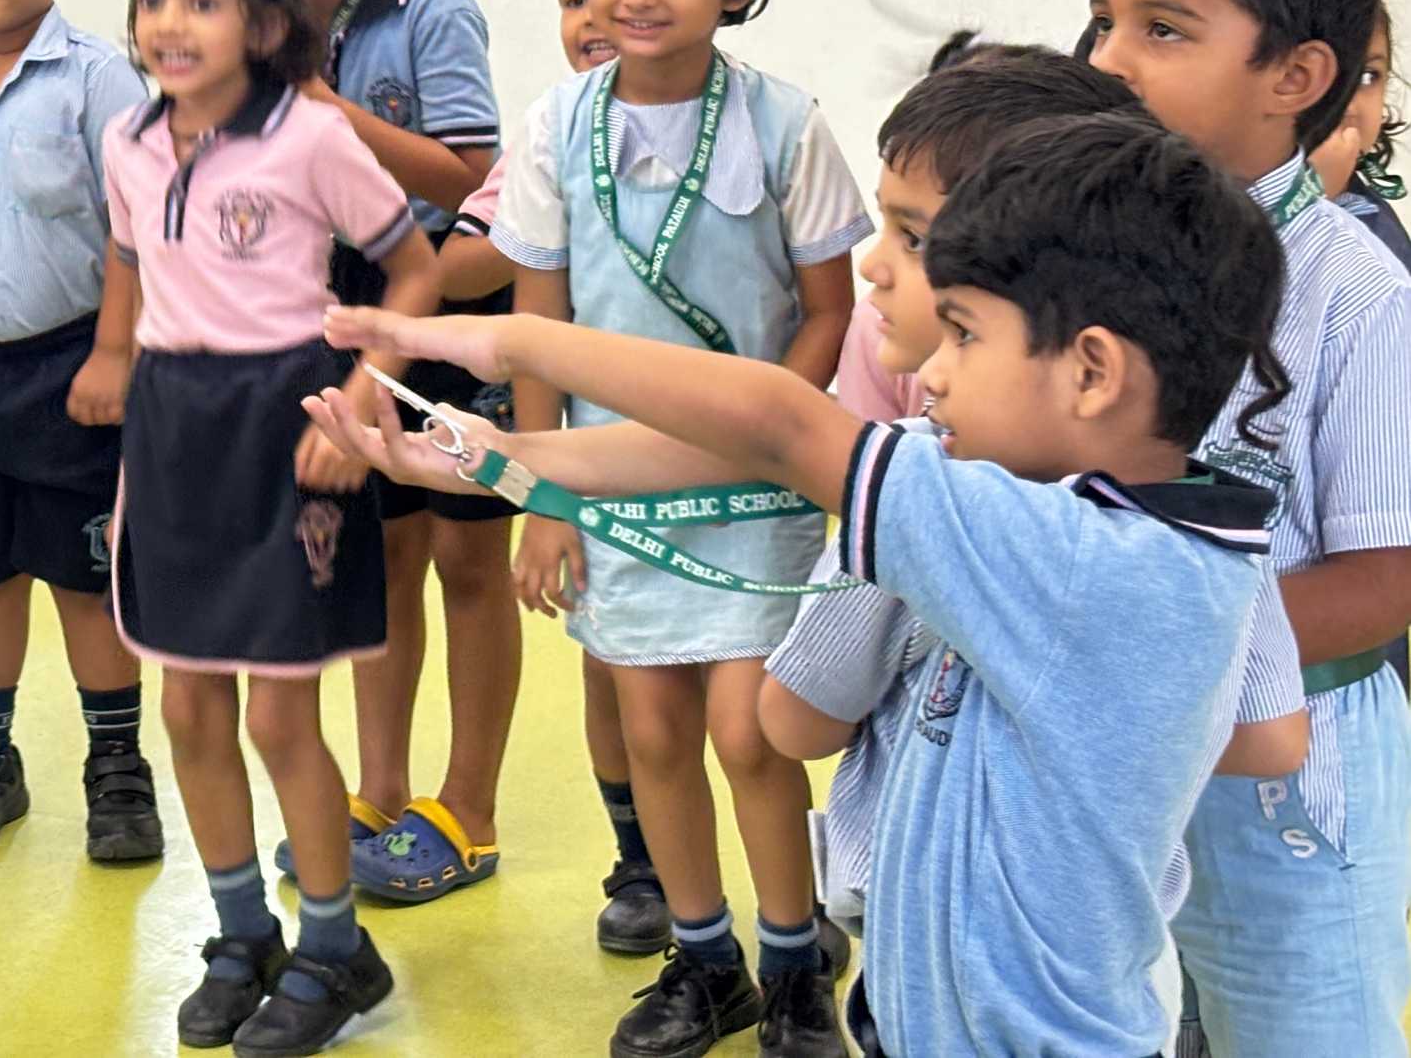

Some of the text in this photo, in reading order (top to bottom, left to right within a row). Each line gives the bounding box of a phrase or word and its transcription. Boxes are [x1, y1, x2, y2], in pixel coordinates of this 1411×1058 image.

[654, 497, 720, 520] PUBLIC
[728, 491, 805, 514] SCHOOL
[607, 522, 667, 559] DELHI
[669, 551, 734, 584] PUBLIC
[1257, 780, 1289, 821] P
[1282, 828, 1318, 859] S
